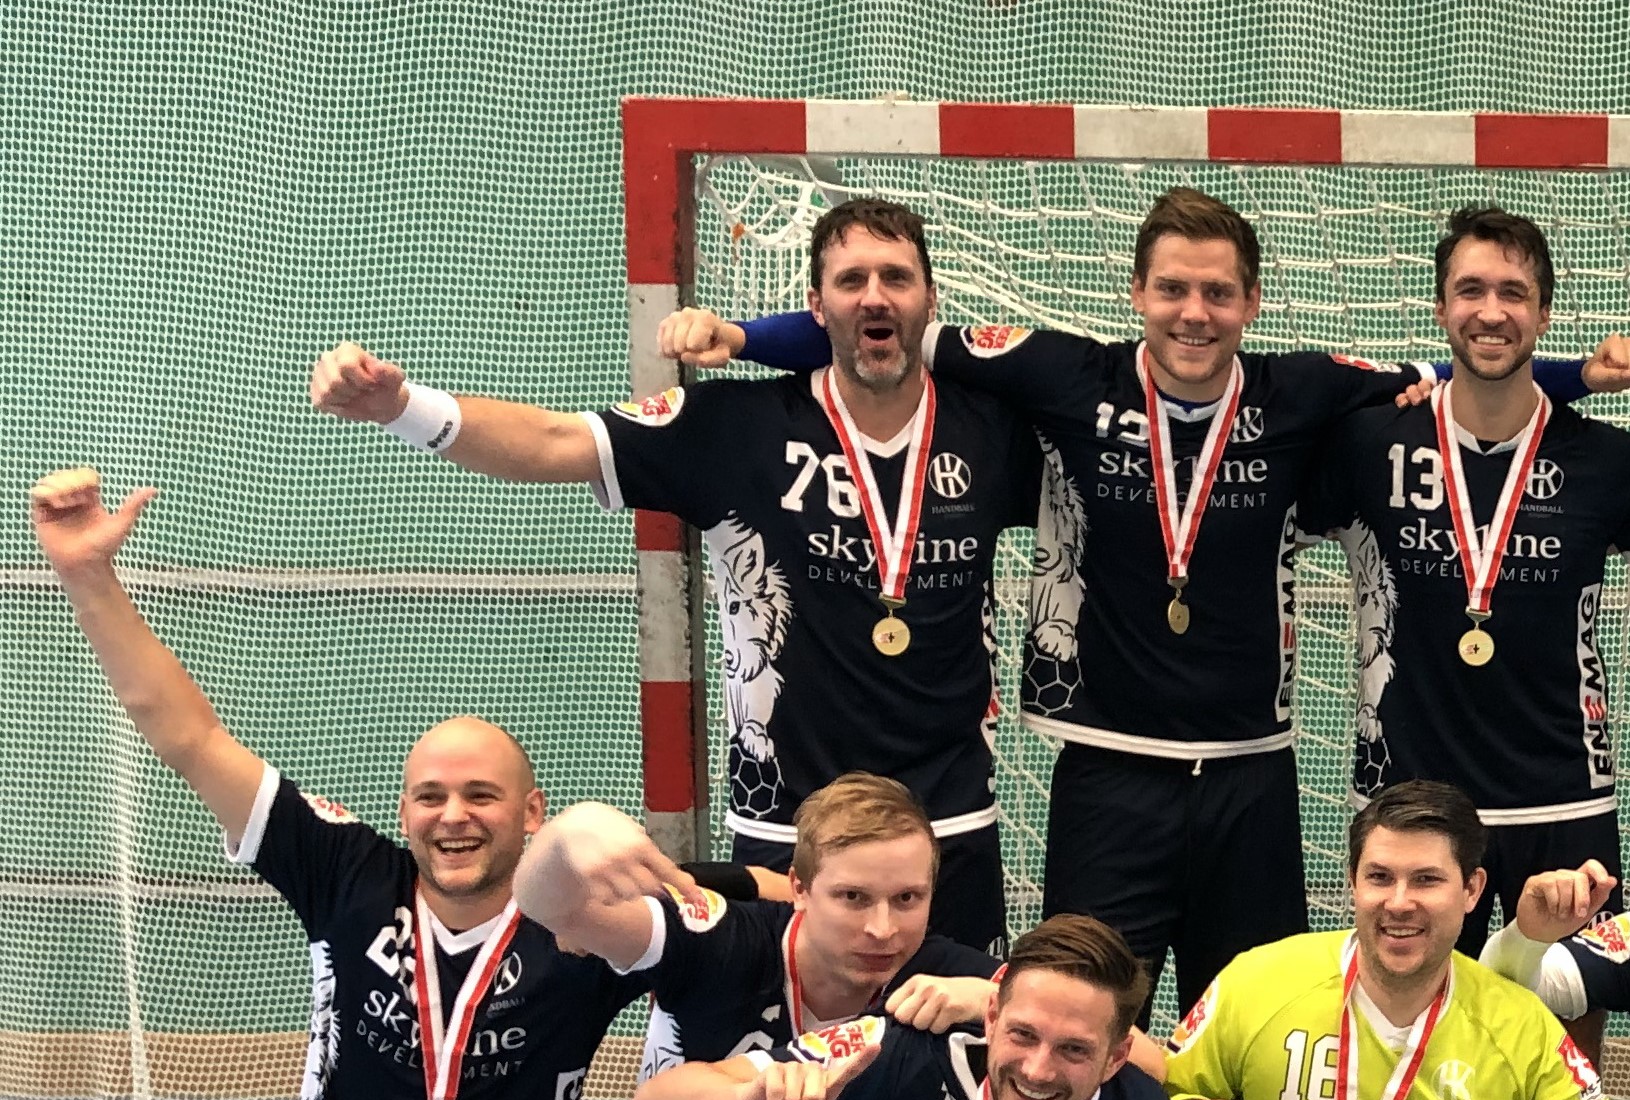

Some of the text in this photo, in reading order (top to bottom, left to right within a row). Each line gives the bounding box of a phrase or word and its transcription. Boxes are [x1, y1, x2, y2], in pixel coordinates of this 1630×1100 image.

[780, 441, 862, 518] 76
[1388, 443, 1443, 511] 13
[807, 524, 979, 573] skyine
[1400, 558, 1560, 583] DEVELMENT
[1581, 592, 1613, 776] ENEMAG
